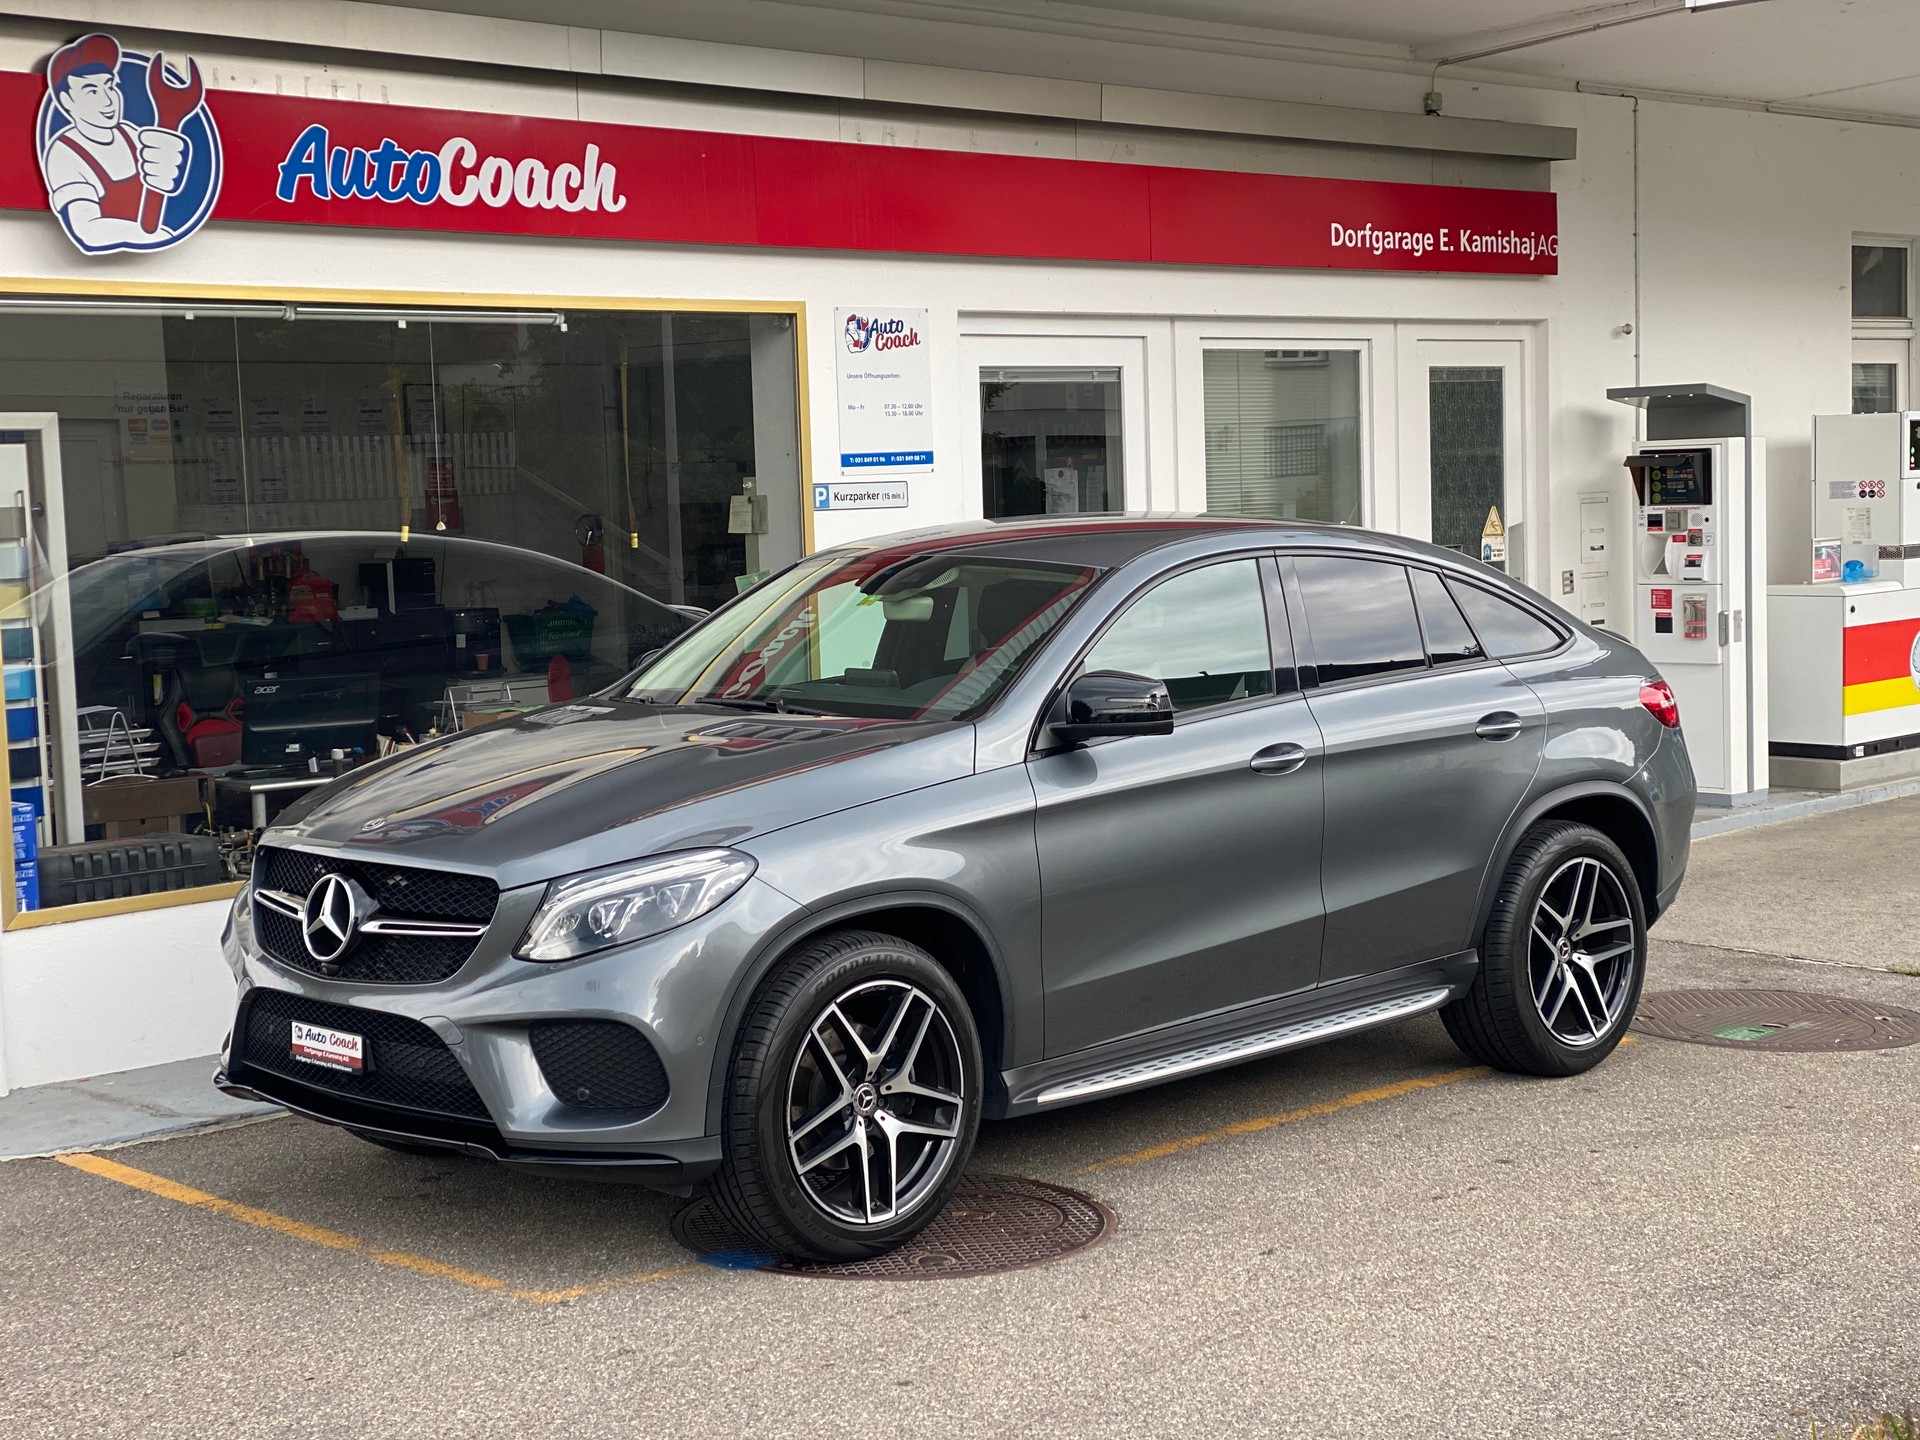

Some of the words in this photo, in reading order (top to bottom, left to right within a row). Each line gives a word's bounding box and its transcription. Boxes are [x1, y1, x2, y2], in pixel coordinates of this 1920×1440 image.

[1331, 223, 1434, 256] Dorfgarage
[1439, 228, 1454, 252] E.
[869, 318, 904, 338] Auto
[874, 327, 921, 351] Coach
[815, 487, 827, 507] P
[833, 490, 880, 504] Kurzparker
[882, 492, 890, 501] (15
[891, 491, 905, 501] min.)
[254, 685, 280, 695] acer
[305, 1028, 326, 1044] Auto
[330, 1033, 359, 1051] Coach
